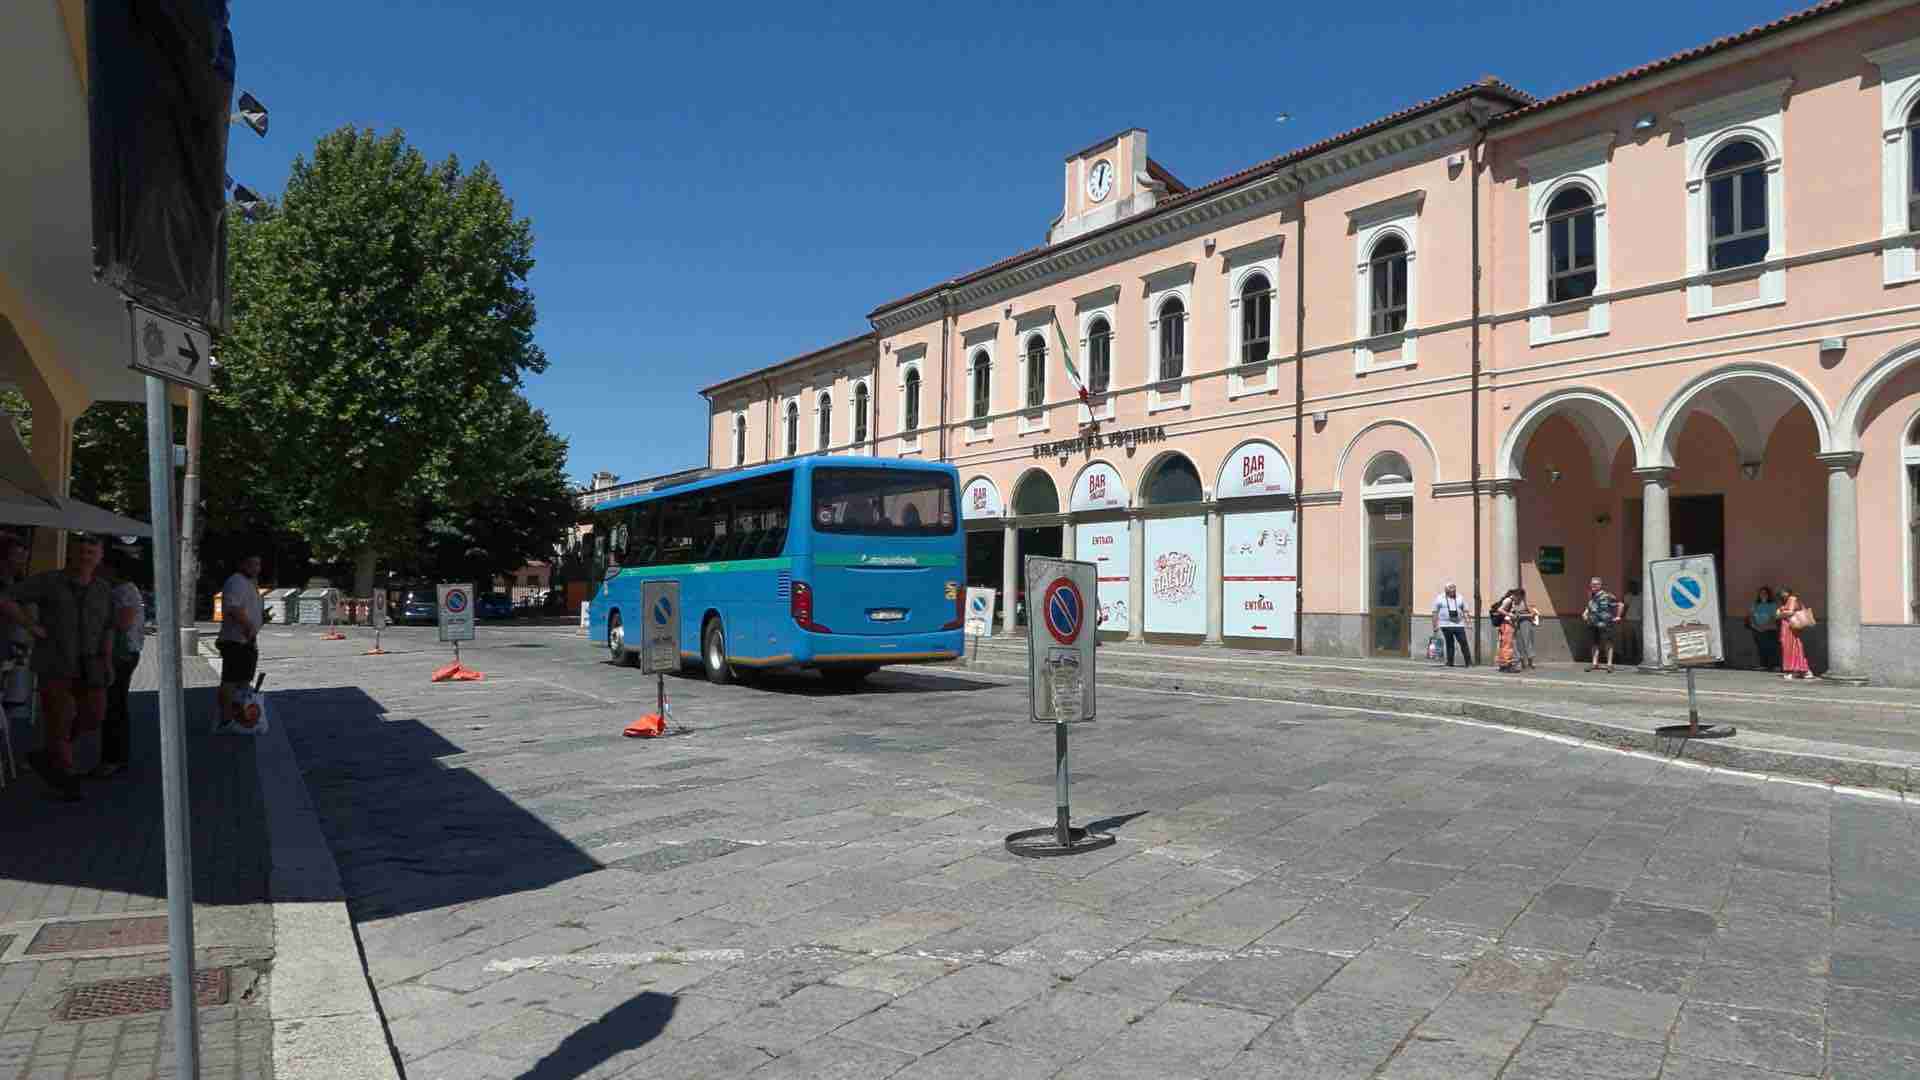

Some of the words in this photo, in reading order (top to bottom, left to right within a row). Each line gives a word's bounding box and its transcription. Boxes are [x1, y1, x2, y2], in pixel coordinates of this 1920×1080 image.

[1243, 455, 1265, 478] BAR
[1089, 474, 1105, 493] BAR
[973, 487, 987, 504] BAR
[1092, 536, 1114, 545] ENTRATA
[1244, 600, 1274, 611] ENTRATA
